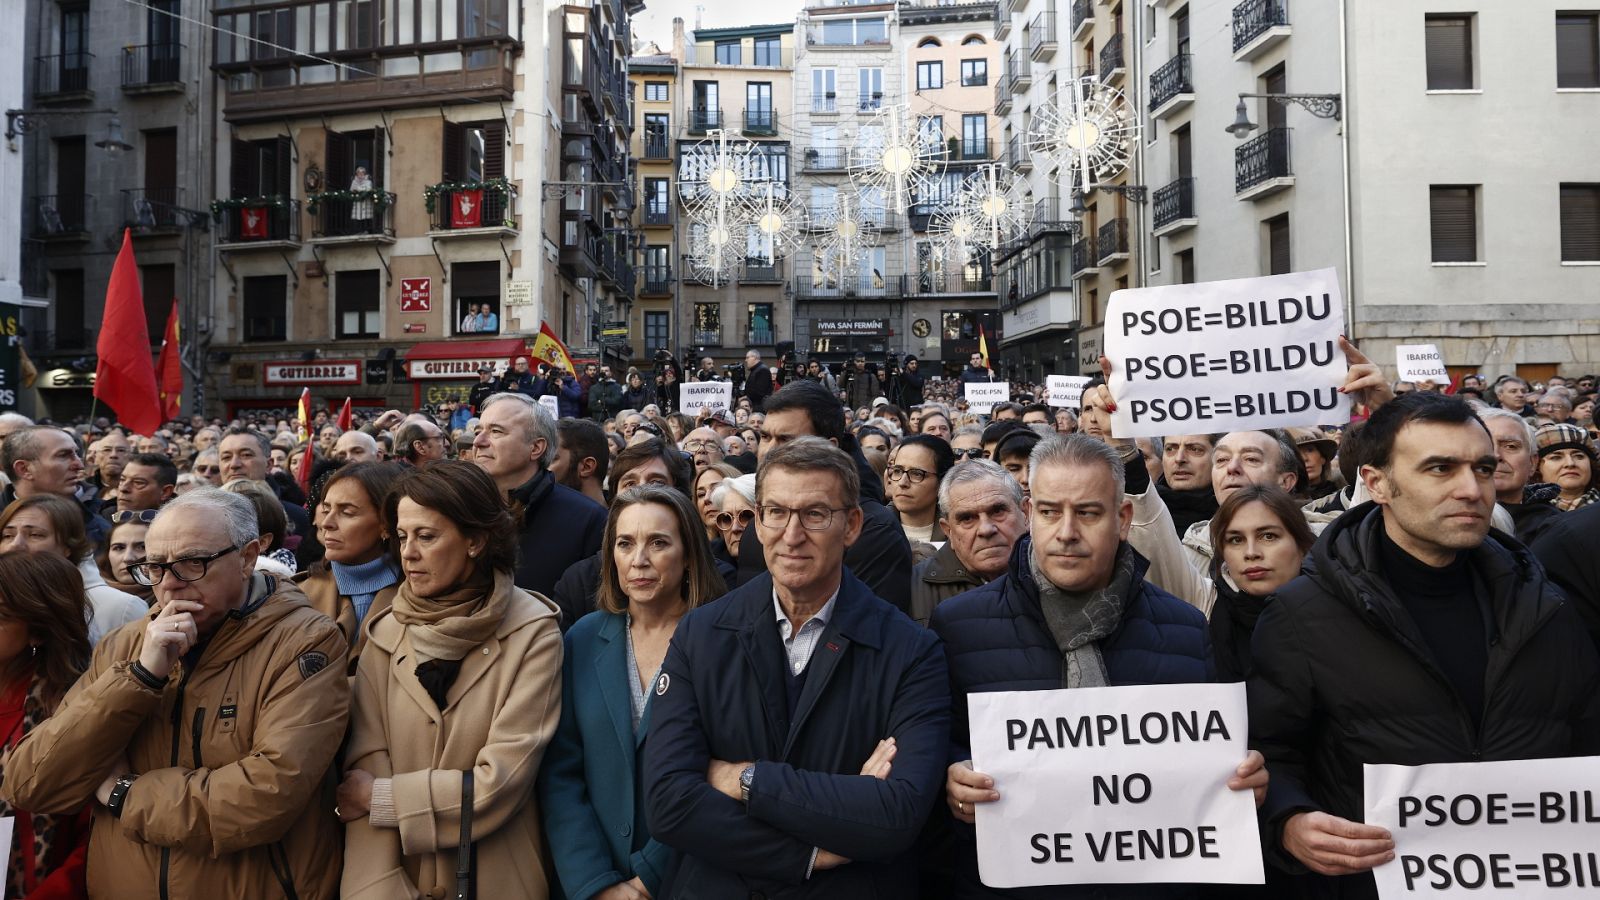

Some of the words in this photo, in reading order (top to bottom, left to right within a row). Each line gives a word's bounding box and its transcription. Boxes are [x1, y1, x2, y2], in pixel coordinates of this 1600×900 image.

[854, 320, 883, 329] FERMÍN!
[1123, 294, 1331, 337] PSOE=BILDU
[279, 367, 346, 379] GUTIERREZ
[1126, 341, 1334, 382] PSOE=BILDU
[1131, 387, 1338, 424] PSOE=BILDU
[1007, 711, 1231, 751] PAMPLONA
[1093, 773, 1152, 806] NO
[1399, 791, 1600, 828] PSOE=BIL
[1031, 833, 1074, 864] SE
[1085, 827, 1220, 862] VENDE
[1401, 853, 1600, 891] PSOE=BIL
